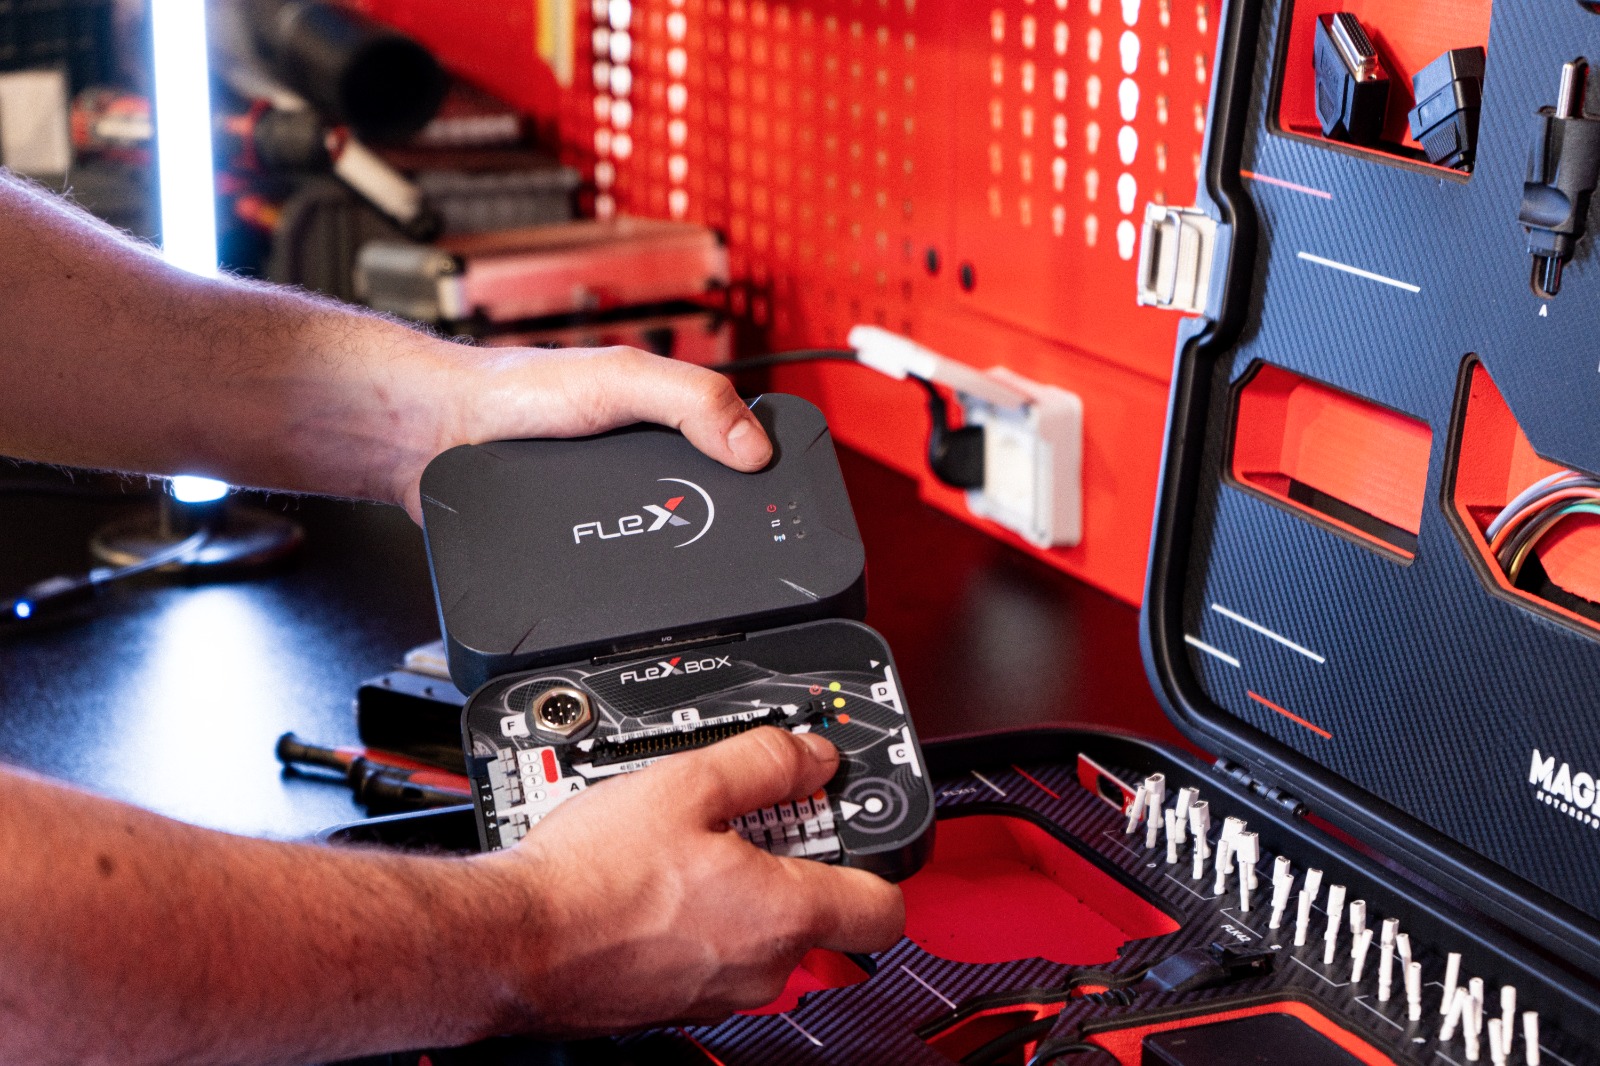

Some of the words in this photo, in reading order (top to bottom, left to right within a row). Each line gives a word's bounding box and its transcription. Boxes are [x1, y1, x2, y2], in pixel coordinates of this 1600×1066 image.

[877, 687, 888, 696] D
[680, 711, 691, 722] E
[506, 721, 516, 731] F
[895, 748, 906, 758] C
[570, 782, 581, 792] A
[1528, 748, 1600, 818] MAG
[487, 822, 498, 831] 4
